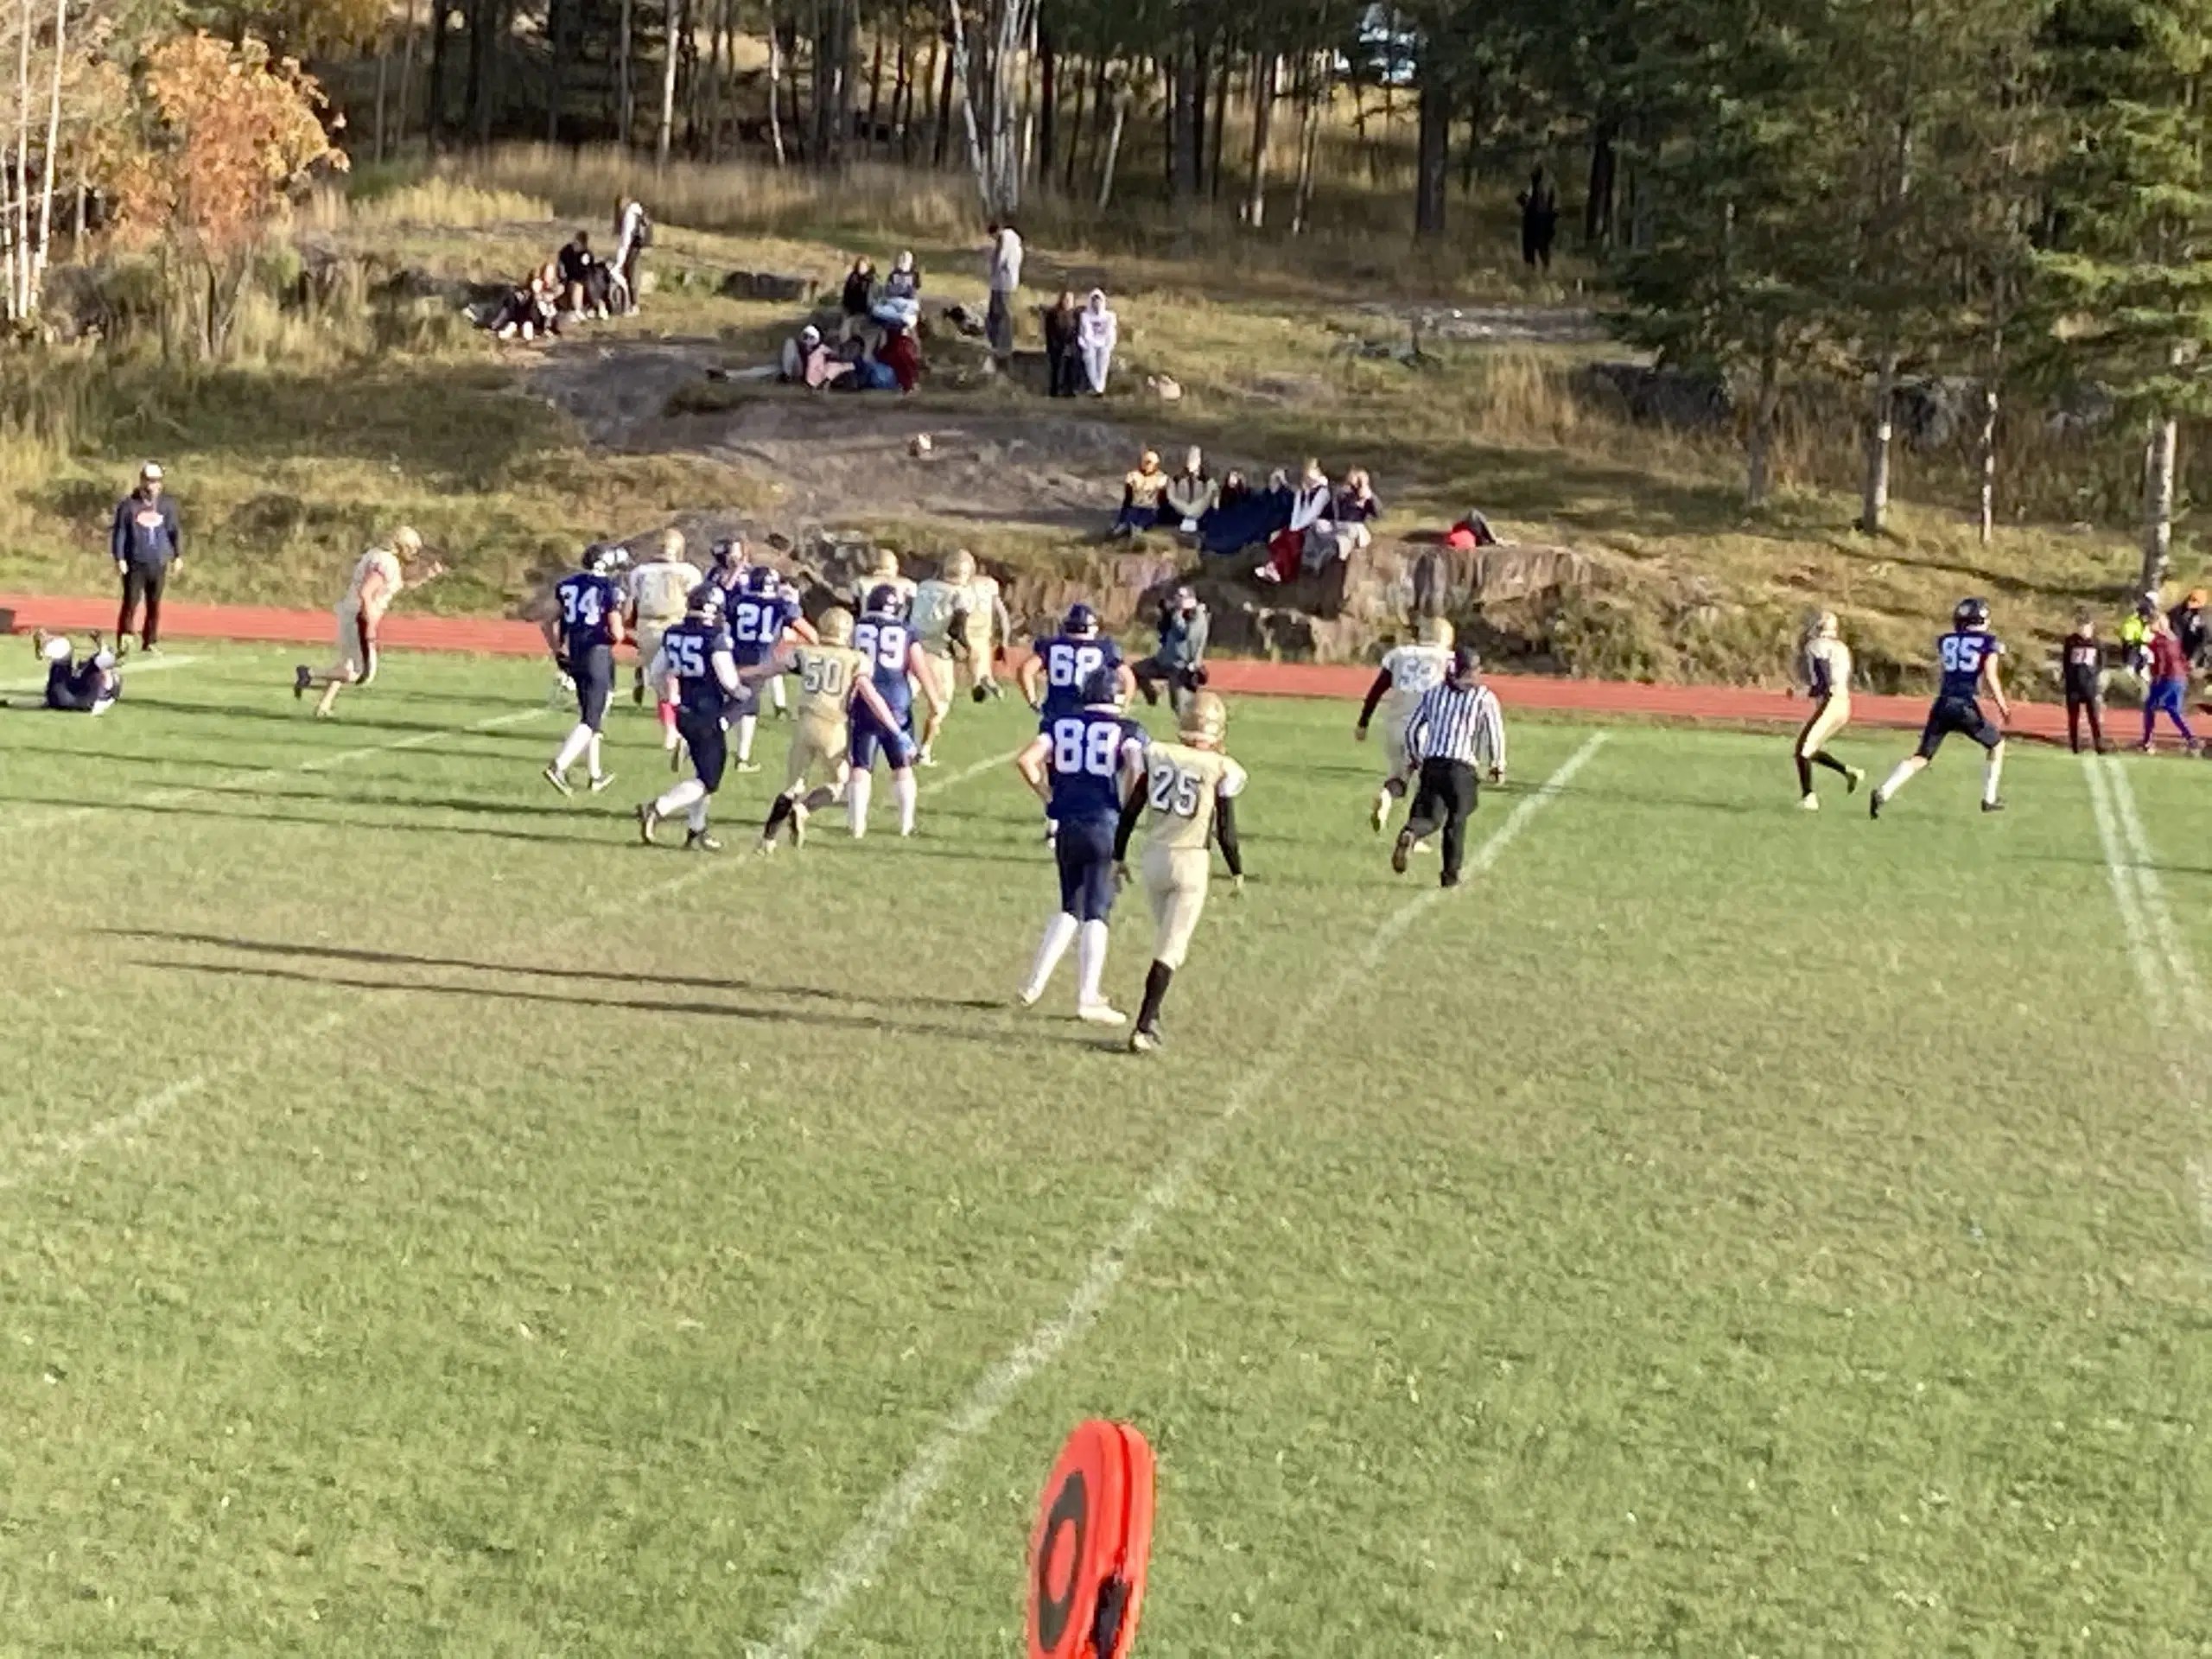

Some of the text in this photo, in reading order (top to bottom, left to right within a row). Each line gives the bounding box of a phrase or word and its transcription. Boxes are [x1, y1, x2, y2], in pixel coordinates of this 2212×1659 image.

[560, 584, 600, 626] 34
[737, 602, 774, 643] 21
[855, 623, 906, 669] 69
[804, 657, 842, 696] 50
[1054, 718, 1122, 777] 88
[1154, 764, 1203, 817] 25
